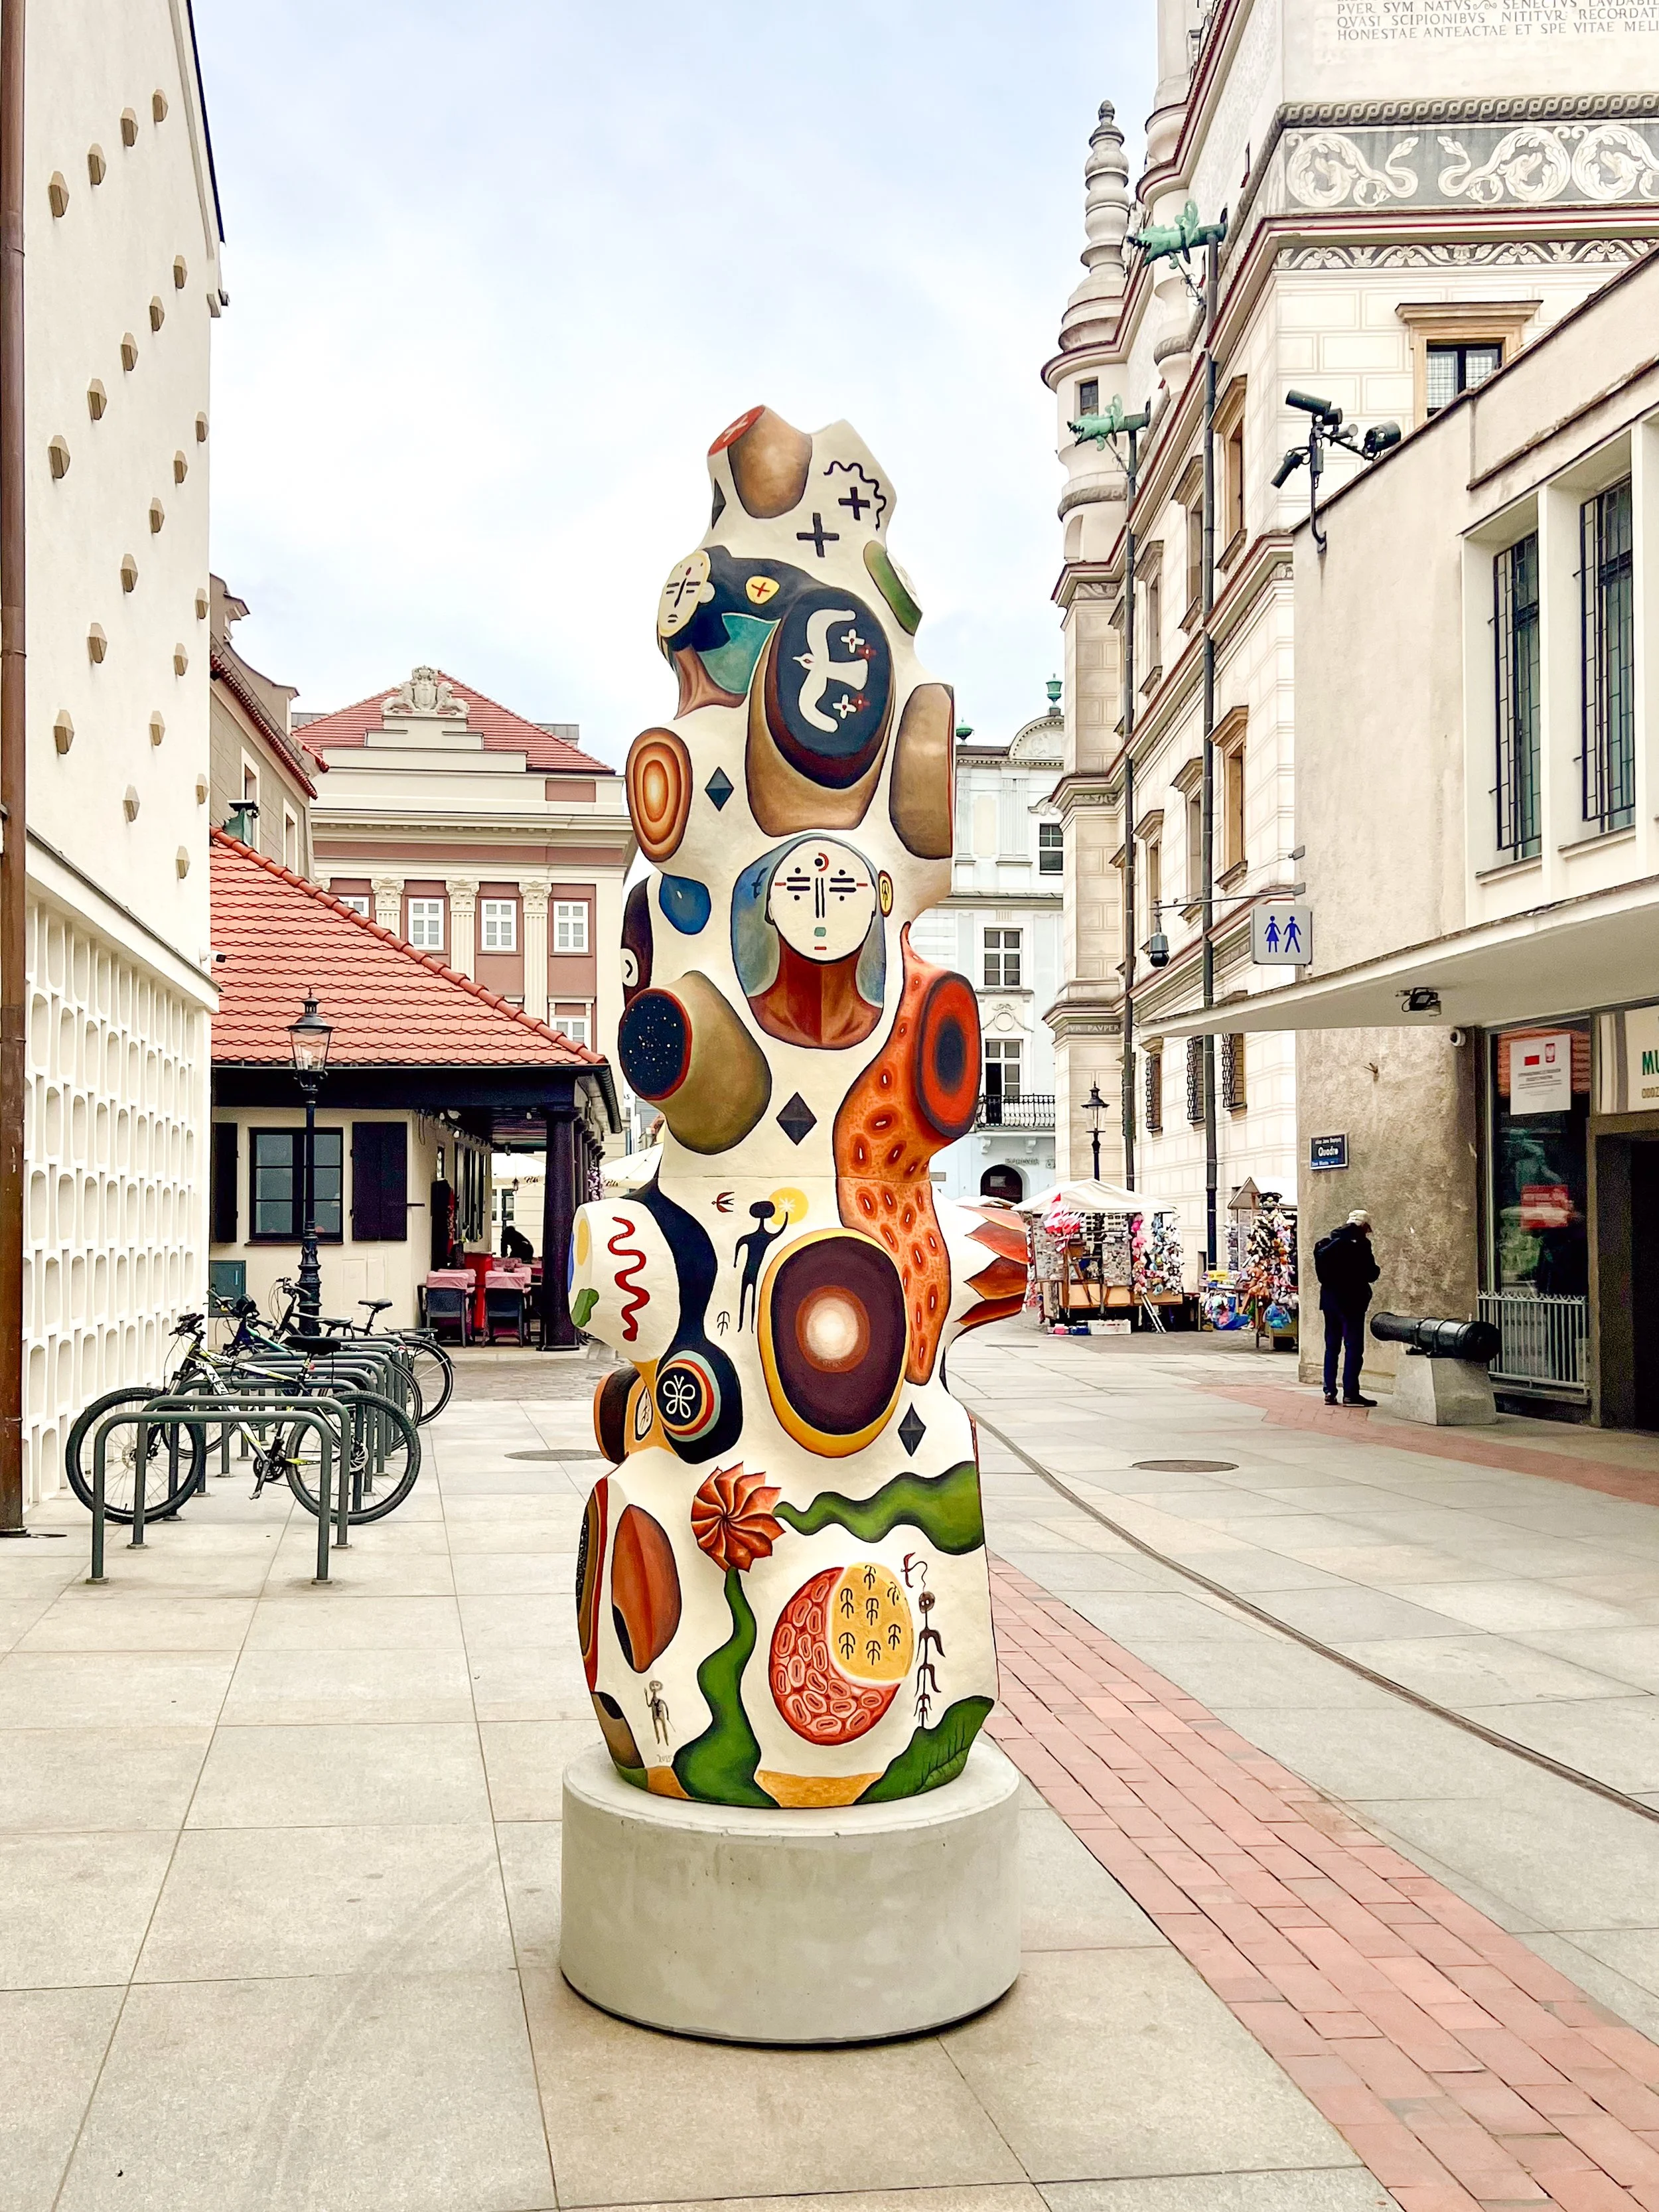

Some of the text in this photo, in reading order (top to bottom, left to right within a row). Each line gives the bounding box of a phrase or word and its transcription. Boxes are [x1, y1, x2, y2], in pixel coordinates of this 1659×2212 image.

[1337, 3, 1376, 15] PVER
[1383, 1, 1413, 13] SVM
[1424, 0, 1471, 11] NATVS
[1337, 15, 1381, 29] QVASI
[1392, 12, 1485, 26] SCIPIONIBVS
[1337, 27, 1417, 40] HONESTAE
[1423, 25, 1507, 38] ANTEACTAE
[1515, 24, 1532, 36] ET
[1540, 23, 1567, 34] SPE
[1573, 21, 1614, 34] VITAE
